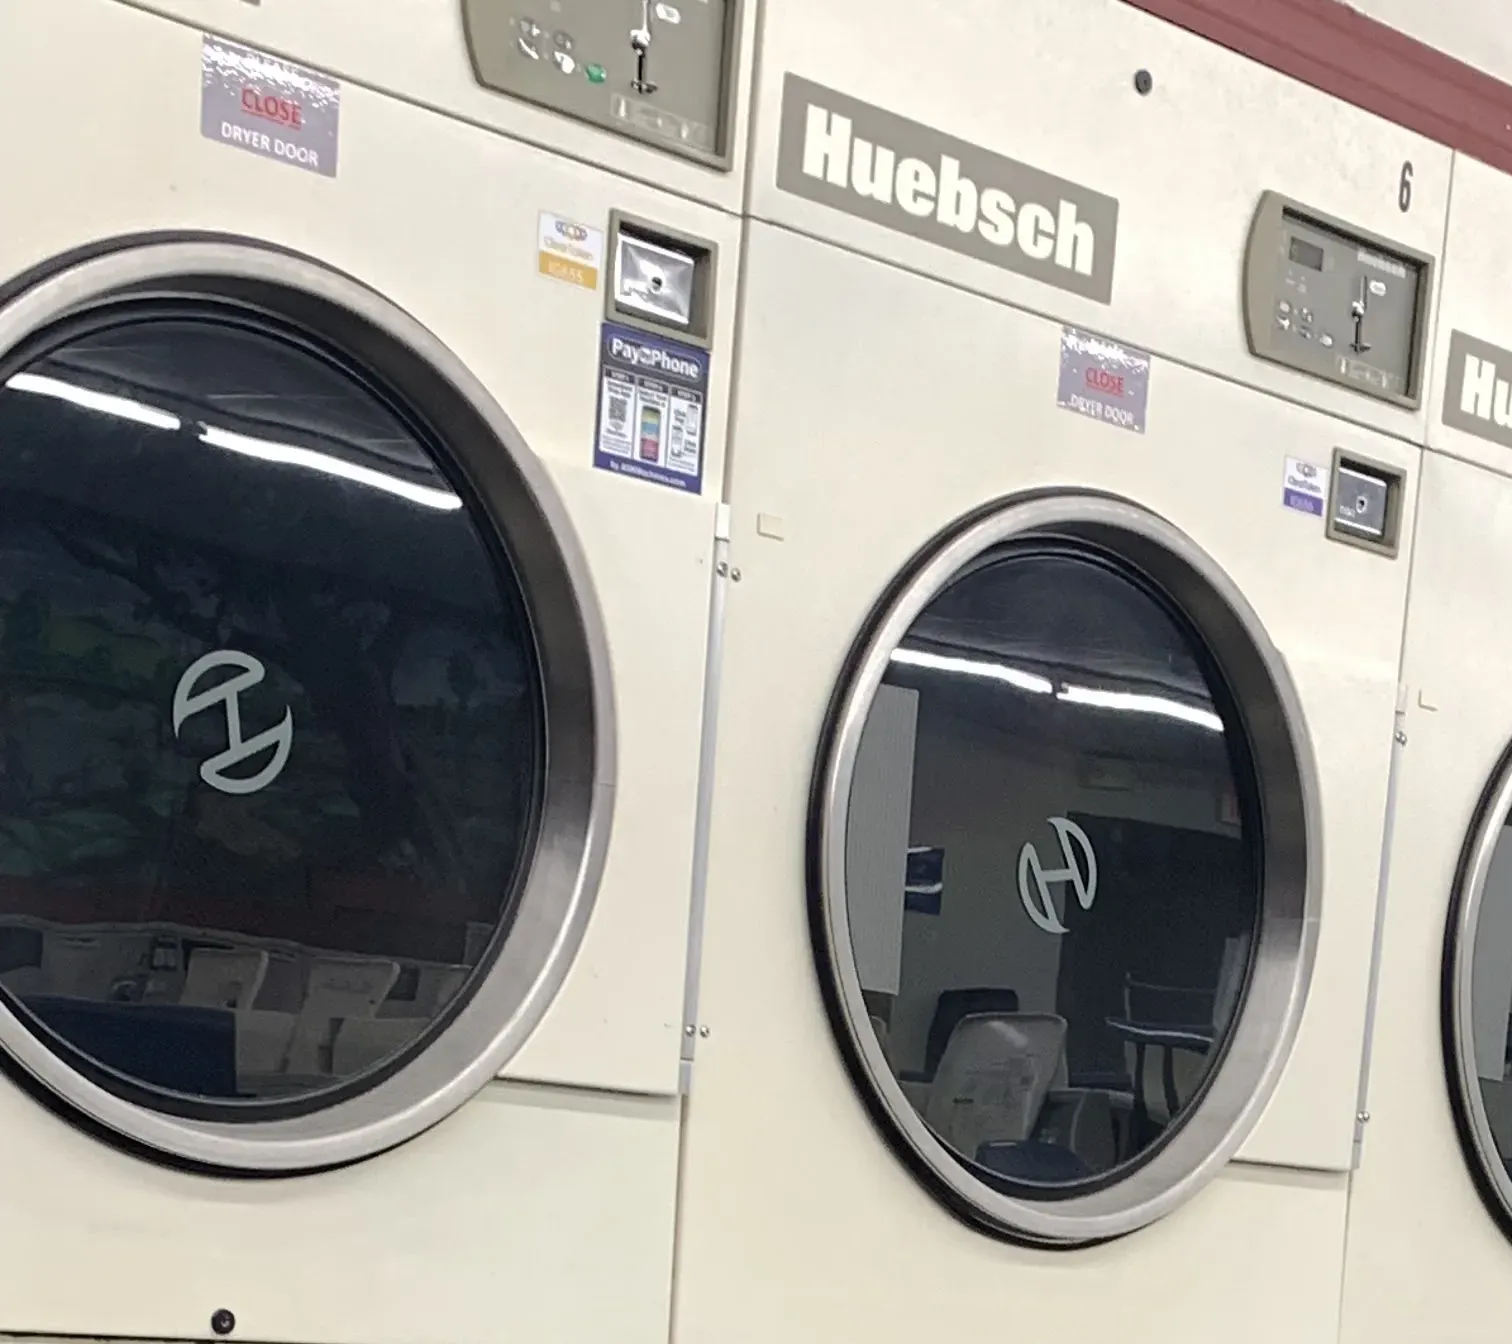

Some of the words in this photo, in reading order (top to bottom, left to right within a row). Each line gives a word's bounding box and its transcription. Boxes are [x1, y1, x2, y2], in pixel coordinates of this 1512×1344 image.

[241, 87, 302, 125] CLOSE
[221, 121, 271, 153] DRYER
[274, 138, 319, 167] DOOR
[803, 103, 1094, 276] Huebsch
[1398, 160, 1413, 213] 6
[1086, 367, 1125, 394] CLOSE
[1104, 405, 1135, 424] DOOR
